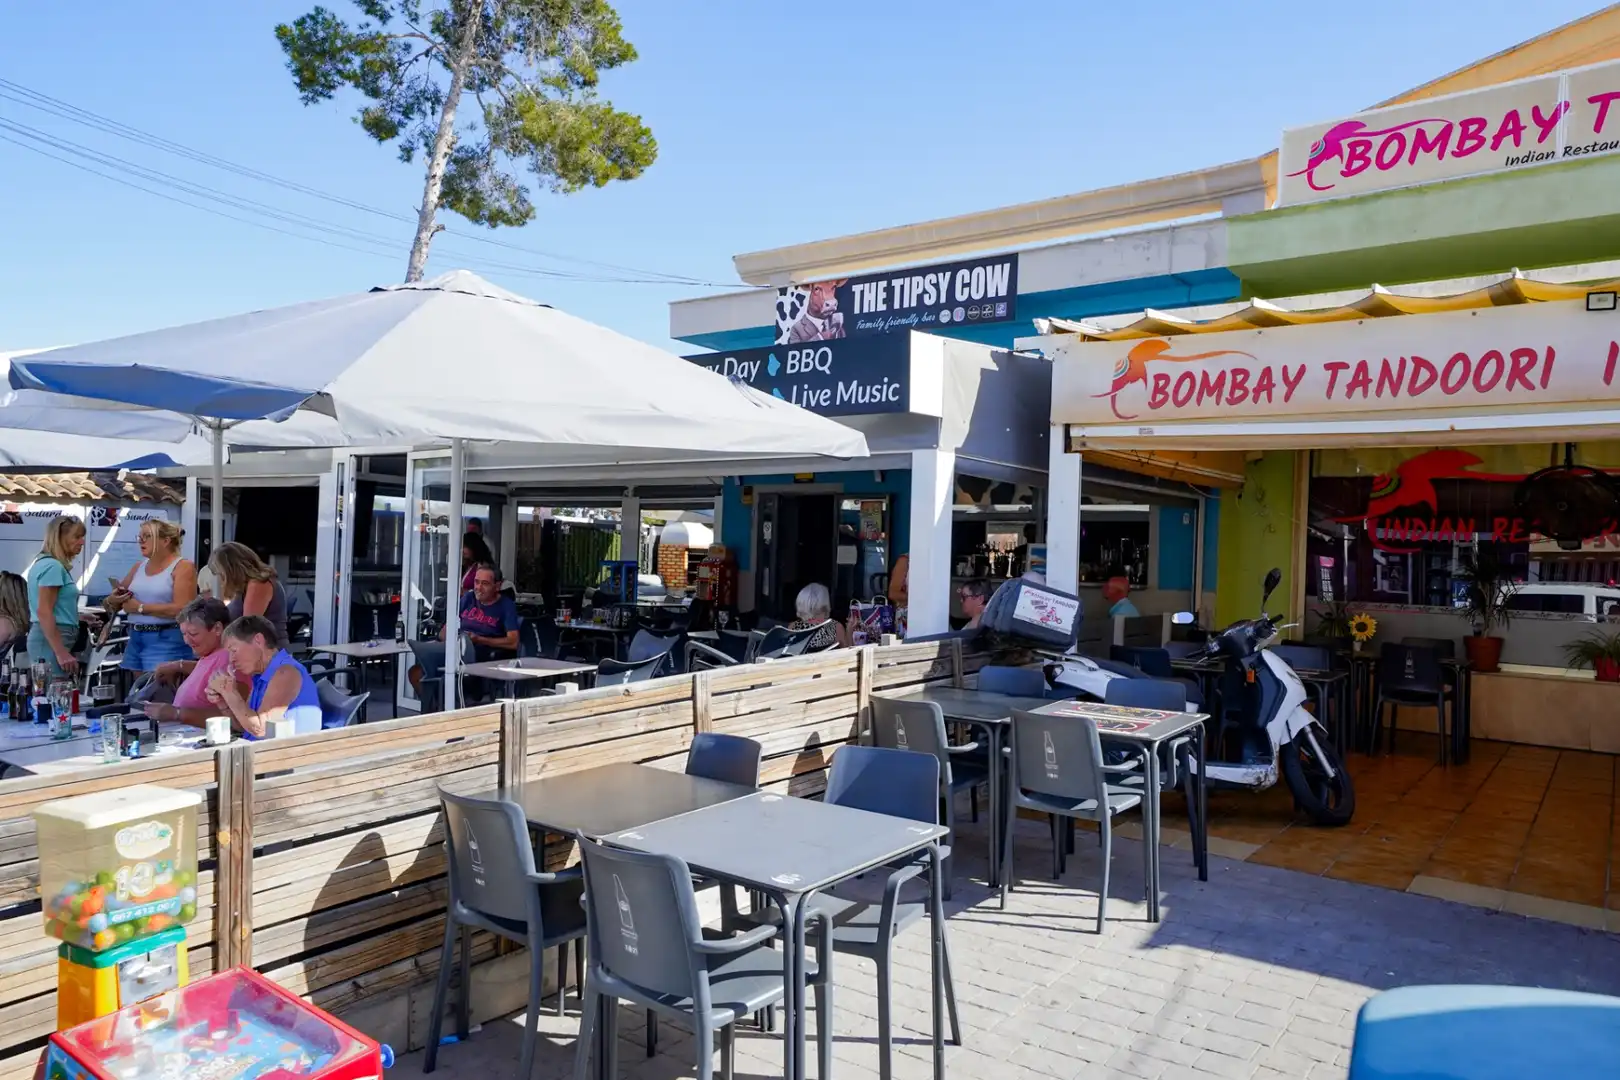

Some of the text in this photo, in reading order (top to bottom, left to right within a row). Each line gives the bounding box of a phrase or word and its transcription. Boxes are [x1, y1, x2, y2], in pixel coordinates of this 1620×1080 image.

[1340, 101, 1570, 178] BOMBAY
[1505, 151, 1556, 167] Indian
[851, 262, 1011, 315] THE TIPSY COW
[856, 317, 885, 331] Family
[884, 312, 920, 332] friendly
[921, 311, 936, 322] bar
[723, 356, 761, 383] Day
[786, 346, 833, 375] BBQ
[791, 376, 900, 407] Live Music
[1147, 363, 1307, 410] BOMBAY
[1323, 345, 1556, 400] TANDOORI
[1384, 516, 1477, 544] INDIAN
